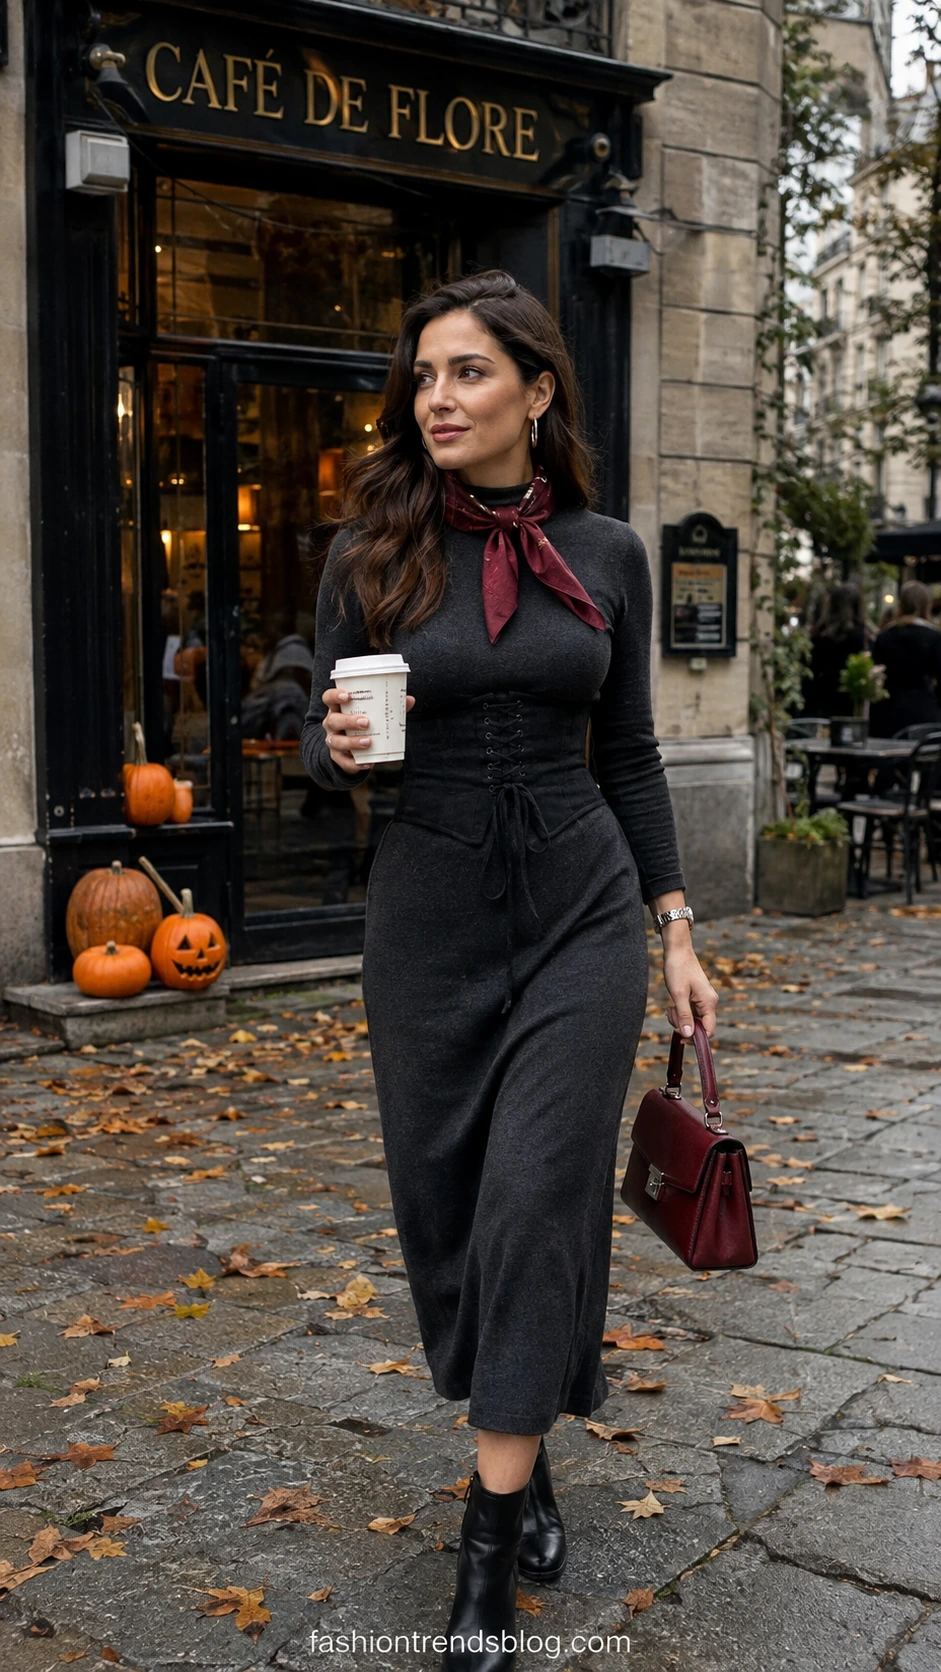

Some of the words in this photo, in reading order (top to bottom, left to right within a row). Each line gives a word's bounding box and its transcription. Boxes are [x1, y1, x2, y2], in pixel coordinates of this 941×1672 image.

[145, 42, 284, 120] CAFÉ
[303, 68, 369, 134] DE
[387, 84, 541, 162] FLORE
